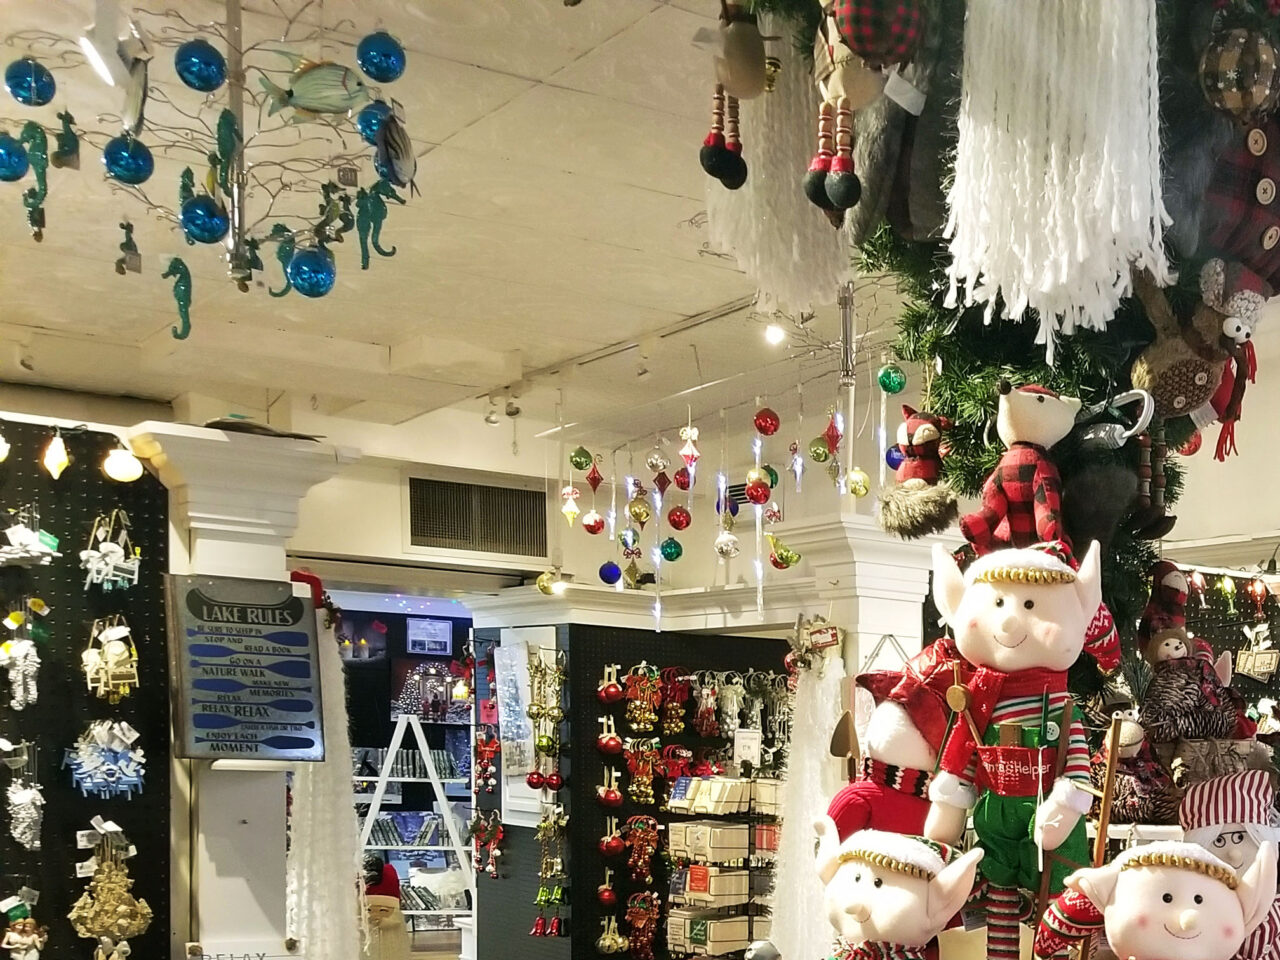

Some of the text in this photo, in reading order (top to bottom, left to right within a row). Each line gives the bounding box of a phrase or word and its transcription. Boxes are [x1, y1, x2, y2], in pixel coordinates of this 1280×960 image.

[202, 606, 293, 625] LAKE RULES
[229, 657, 240, 665] GO
[202, 668, 266, 677] NATURE WALK
[249, 689, 294, 697] MEMORIES
[202, 704, 270, 717] RELAX RELAX
[206, 732, 233, 740] ENJOY
[210, 743, 259, 752] MOMENT
[1014, 756, 1051, 780] Helper
